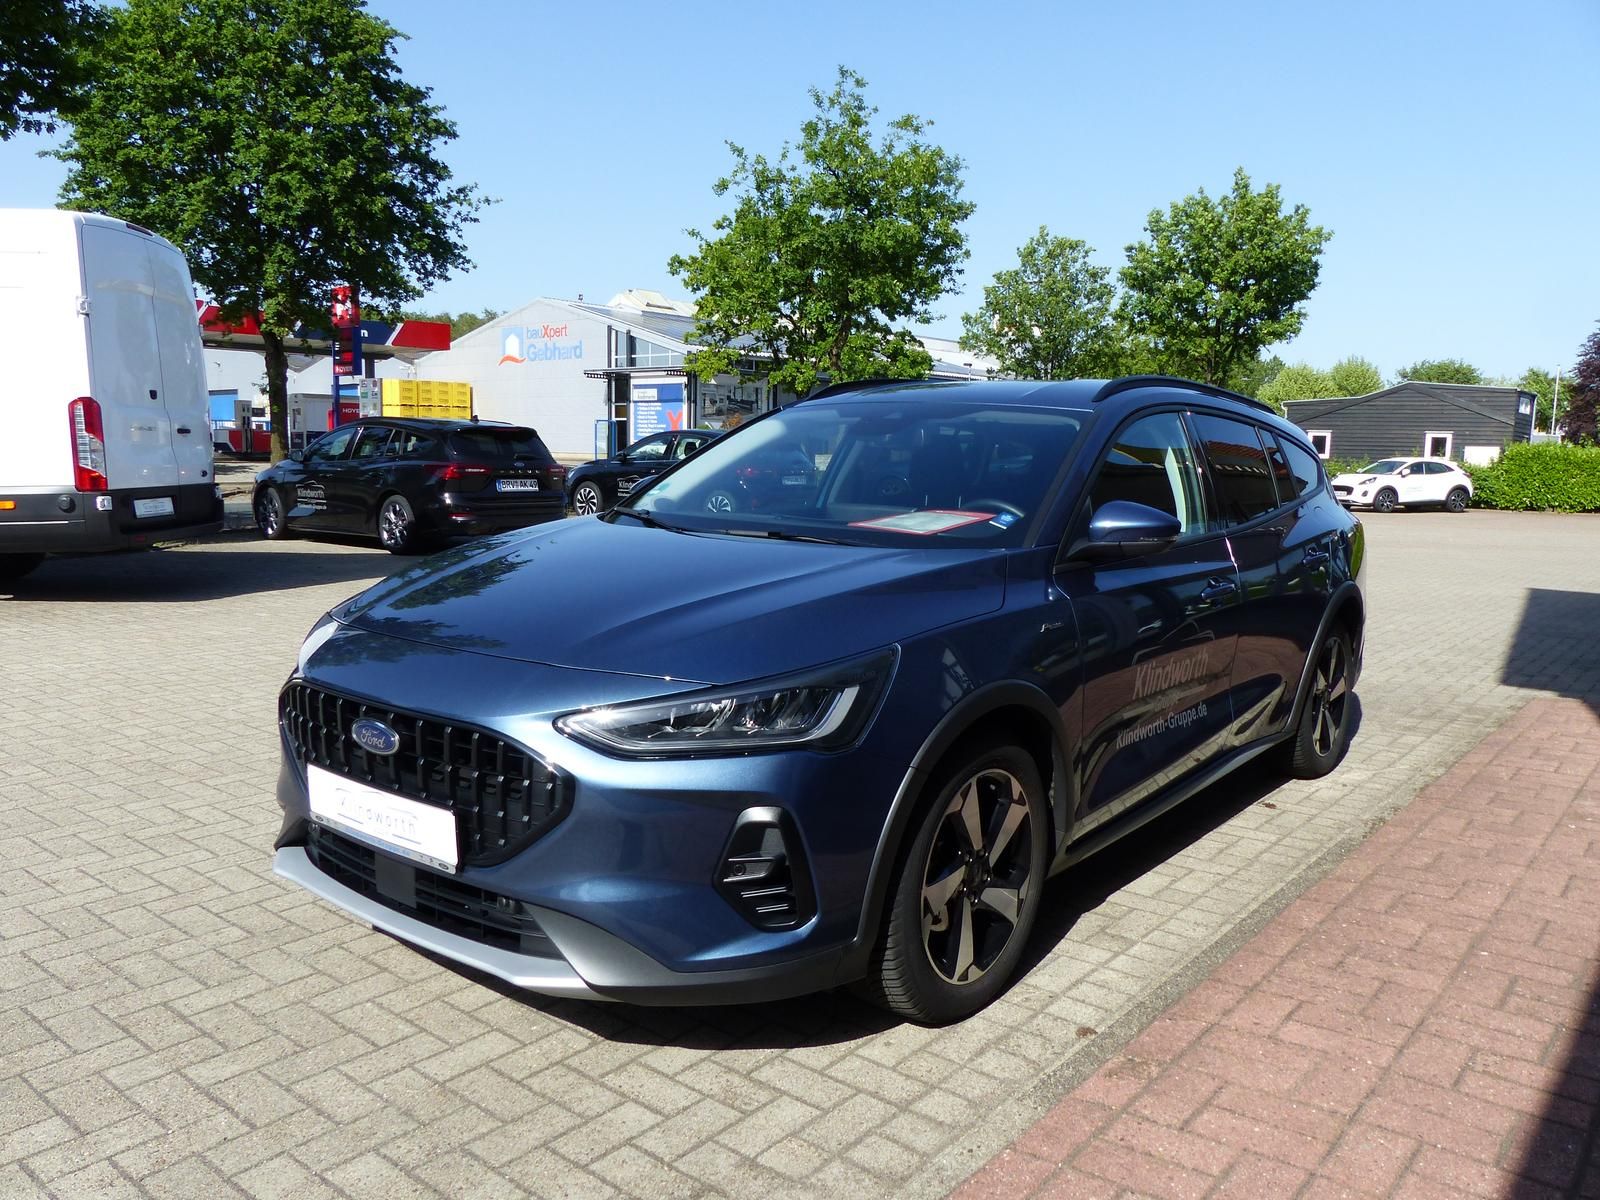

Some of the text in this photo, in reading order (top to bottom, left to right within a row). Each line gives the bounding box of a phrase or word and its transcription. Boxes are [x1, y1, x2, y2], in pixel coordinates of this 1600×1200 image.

[527, 323, 567, 340] bauXpert
[528, 339, 582, 361] Gebhard
[1132, 647, 1209, 700] Klindworth
[1116, 702, 1208, 749] Klindworth-Gruppe.de
[361, 727, 385, 748] Ford
